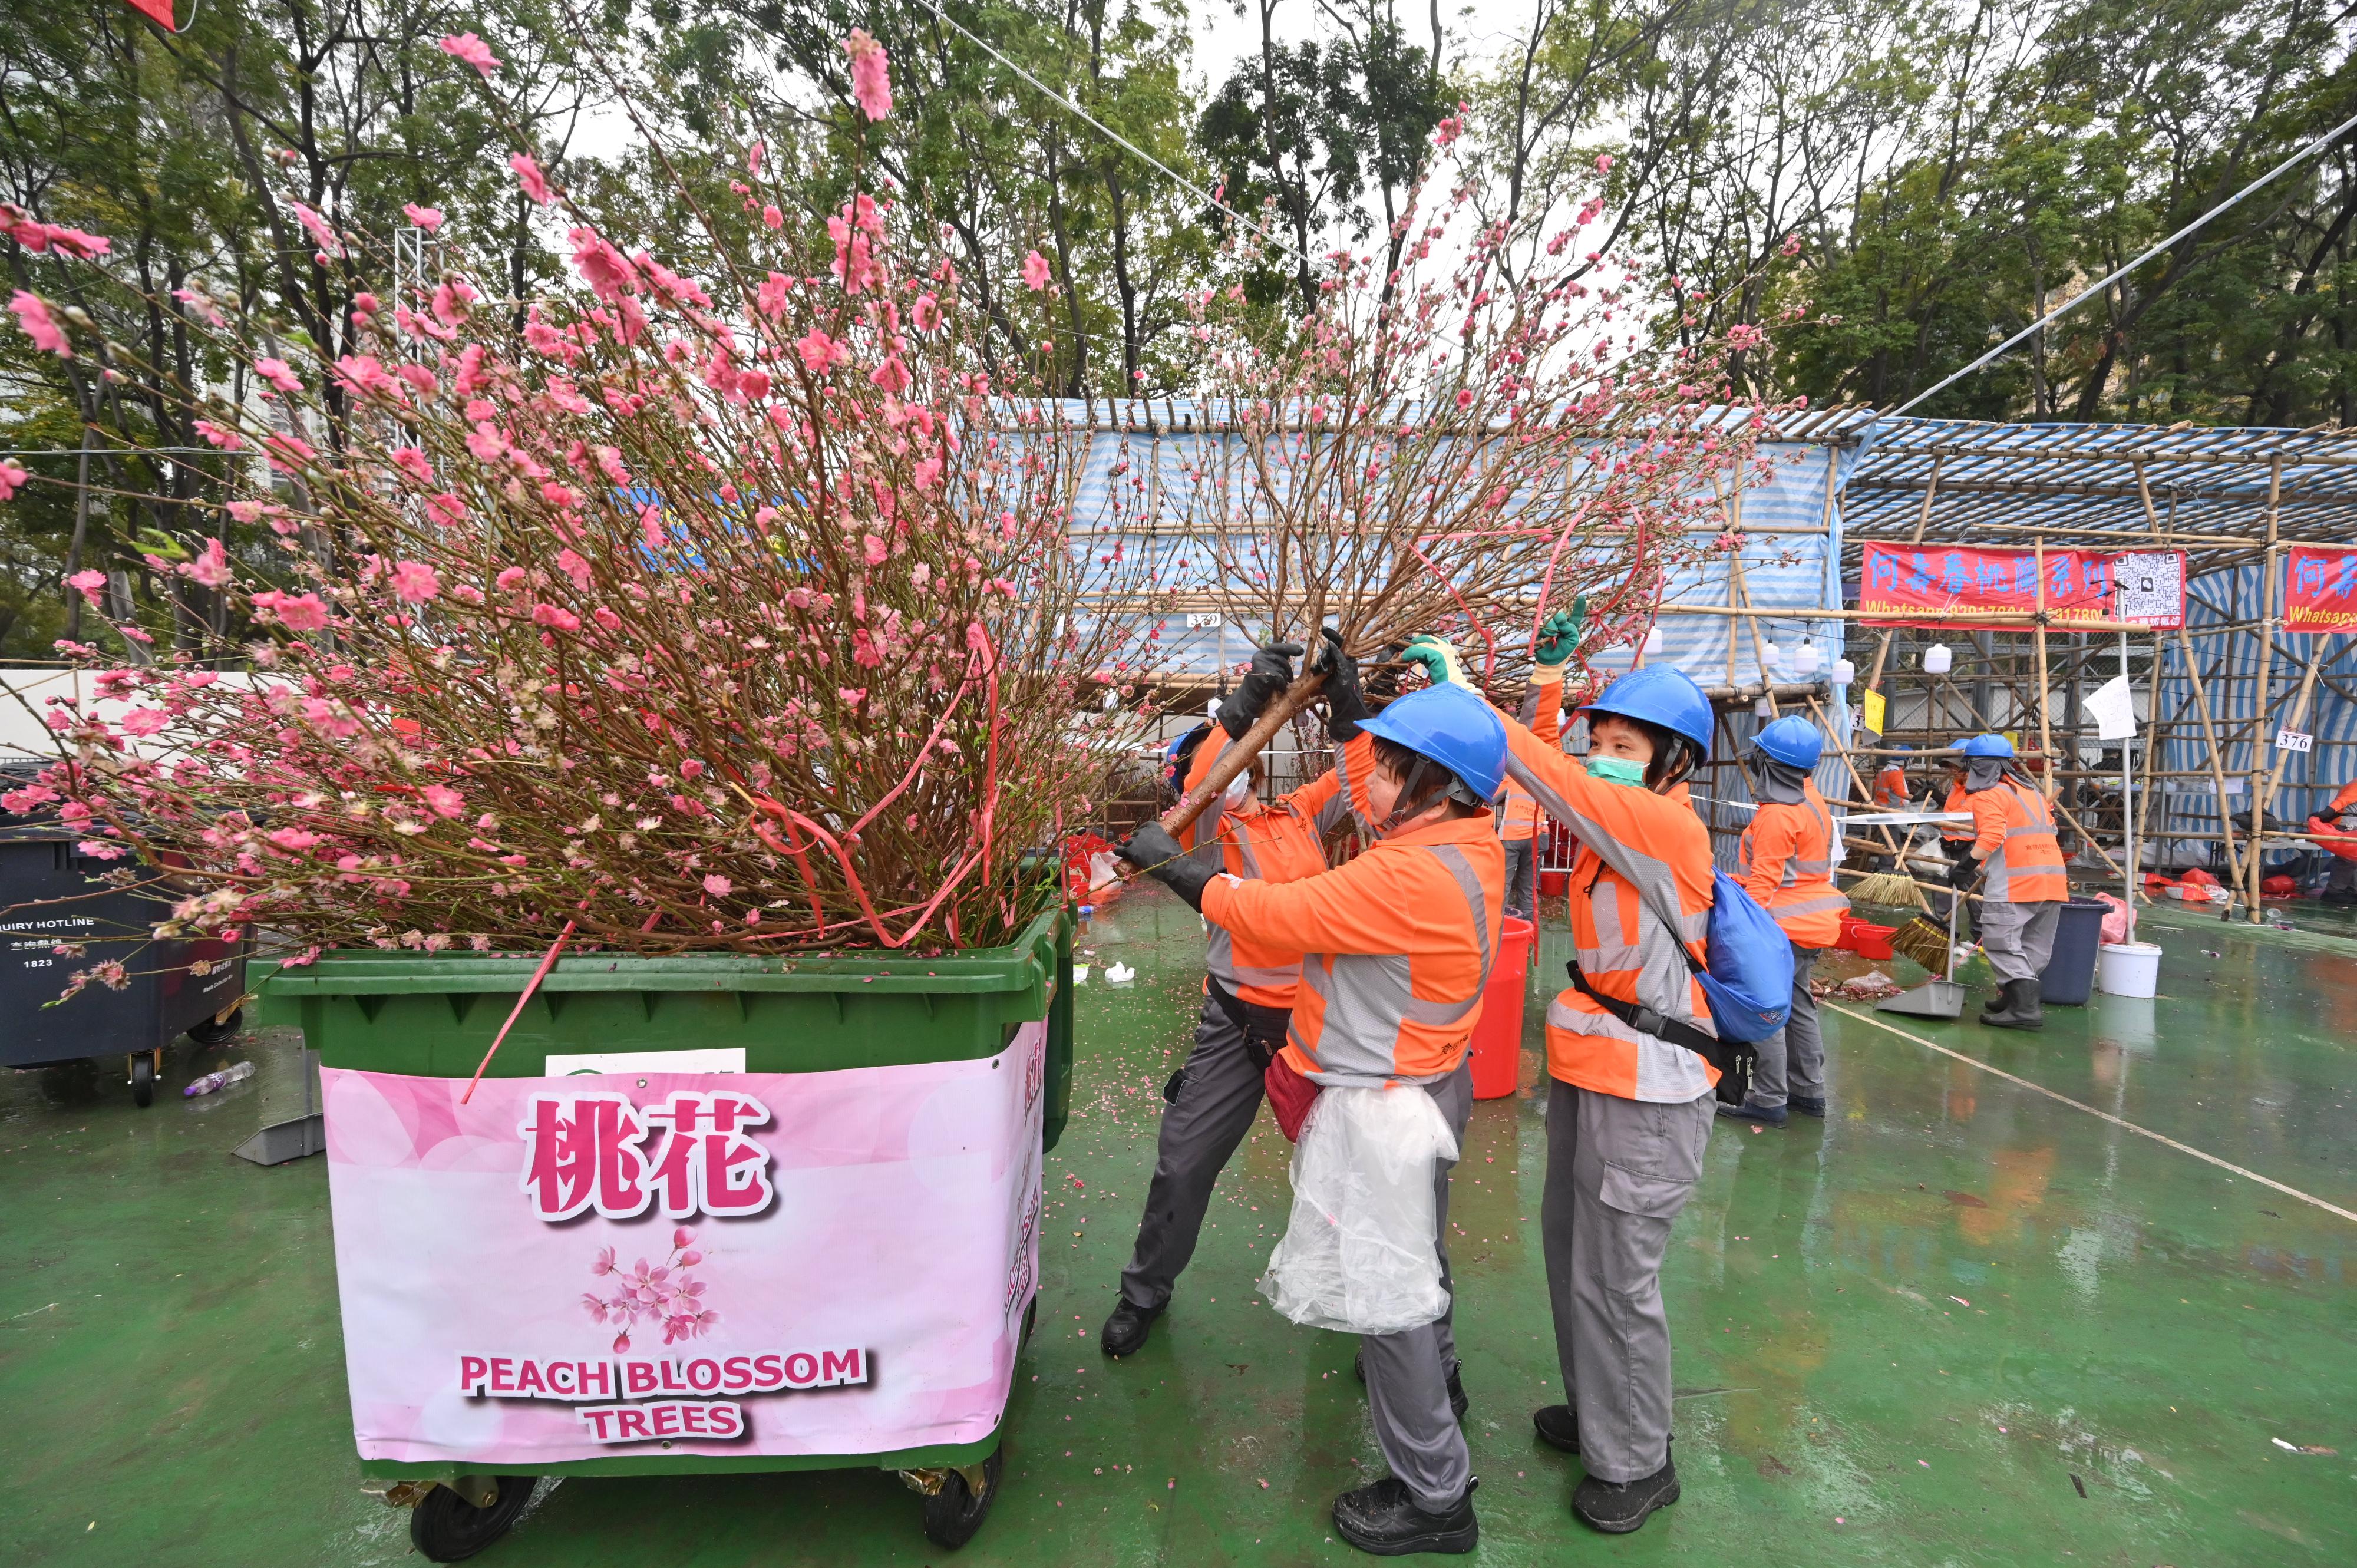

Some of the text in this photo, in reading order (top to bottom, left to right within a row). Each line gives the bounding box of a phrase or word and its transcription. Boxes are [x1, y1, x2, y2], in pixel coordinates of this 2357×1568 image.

[1866, 600, 1945, 613] Whatsa
[1191, 615, 1217, 625] 379
[2280, 734, 2308, 749] 376
[0, 917, 94, 931] UIRY HOTLINE
[24, 959, 53, 968] 1823
[523, 1097, 766, 1214] 桃花
[460, 1348, 860, 1395] PEACH BLOSSOM
[583, 1405, 738, 1439] TREES
